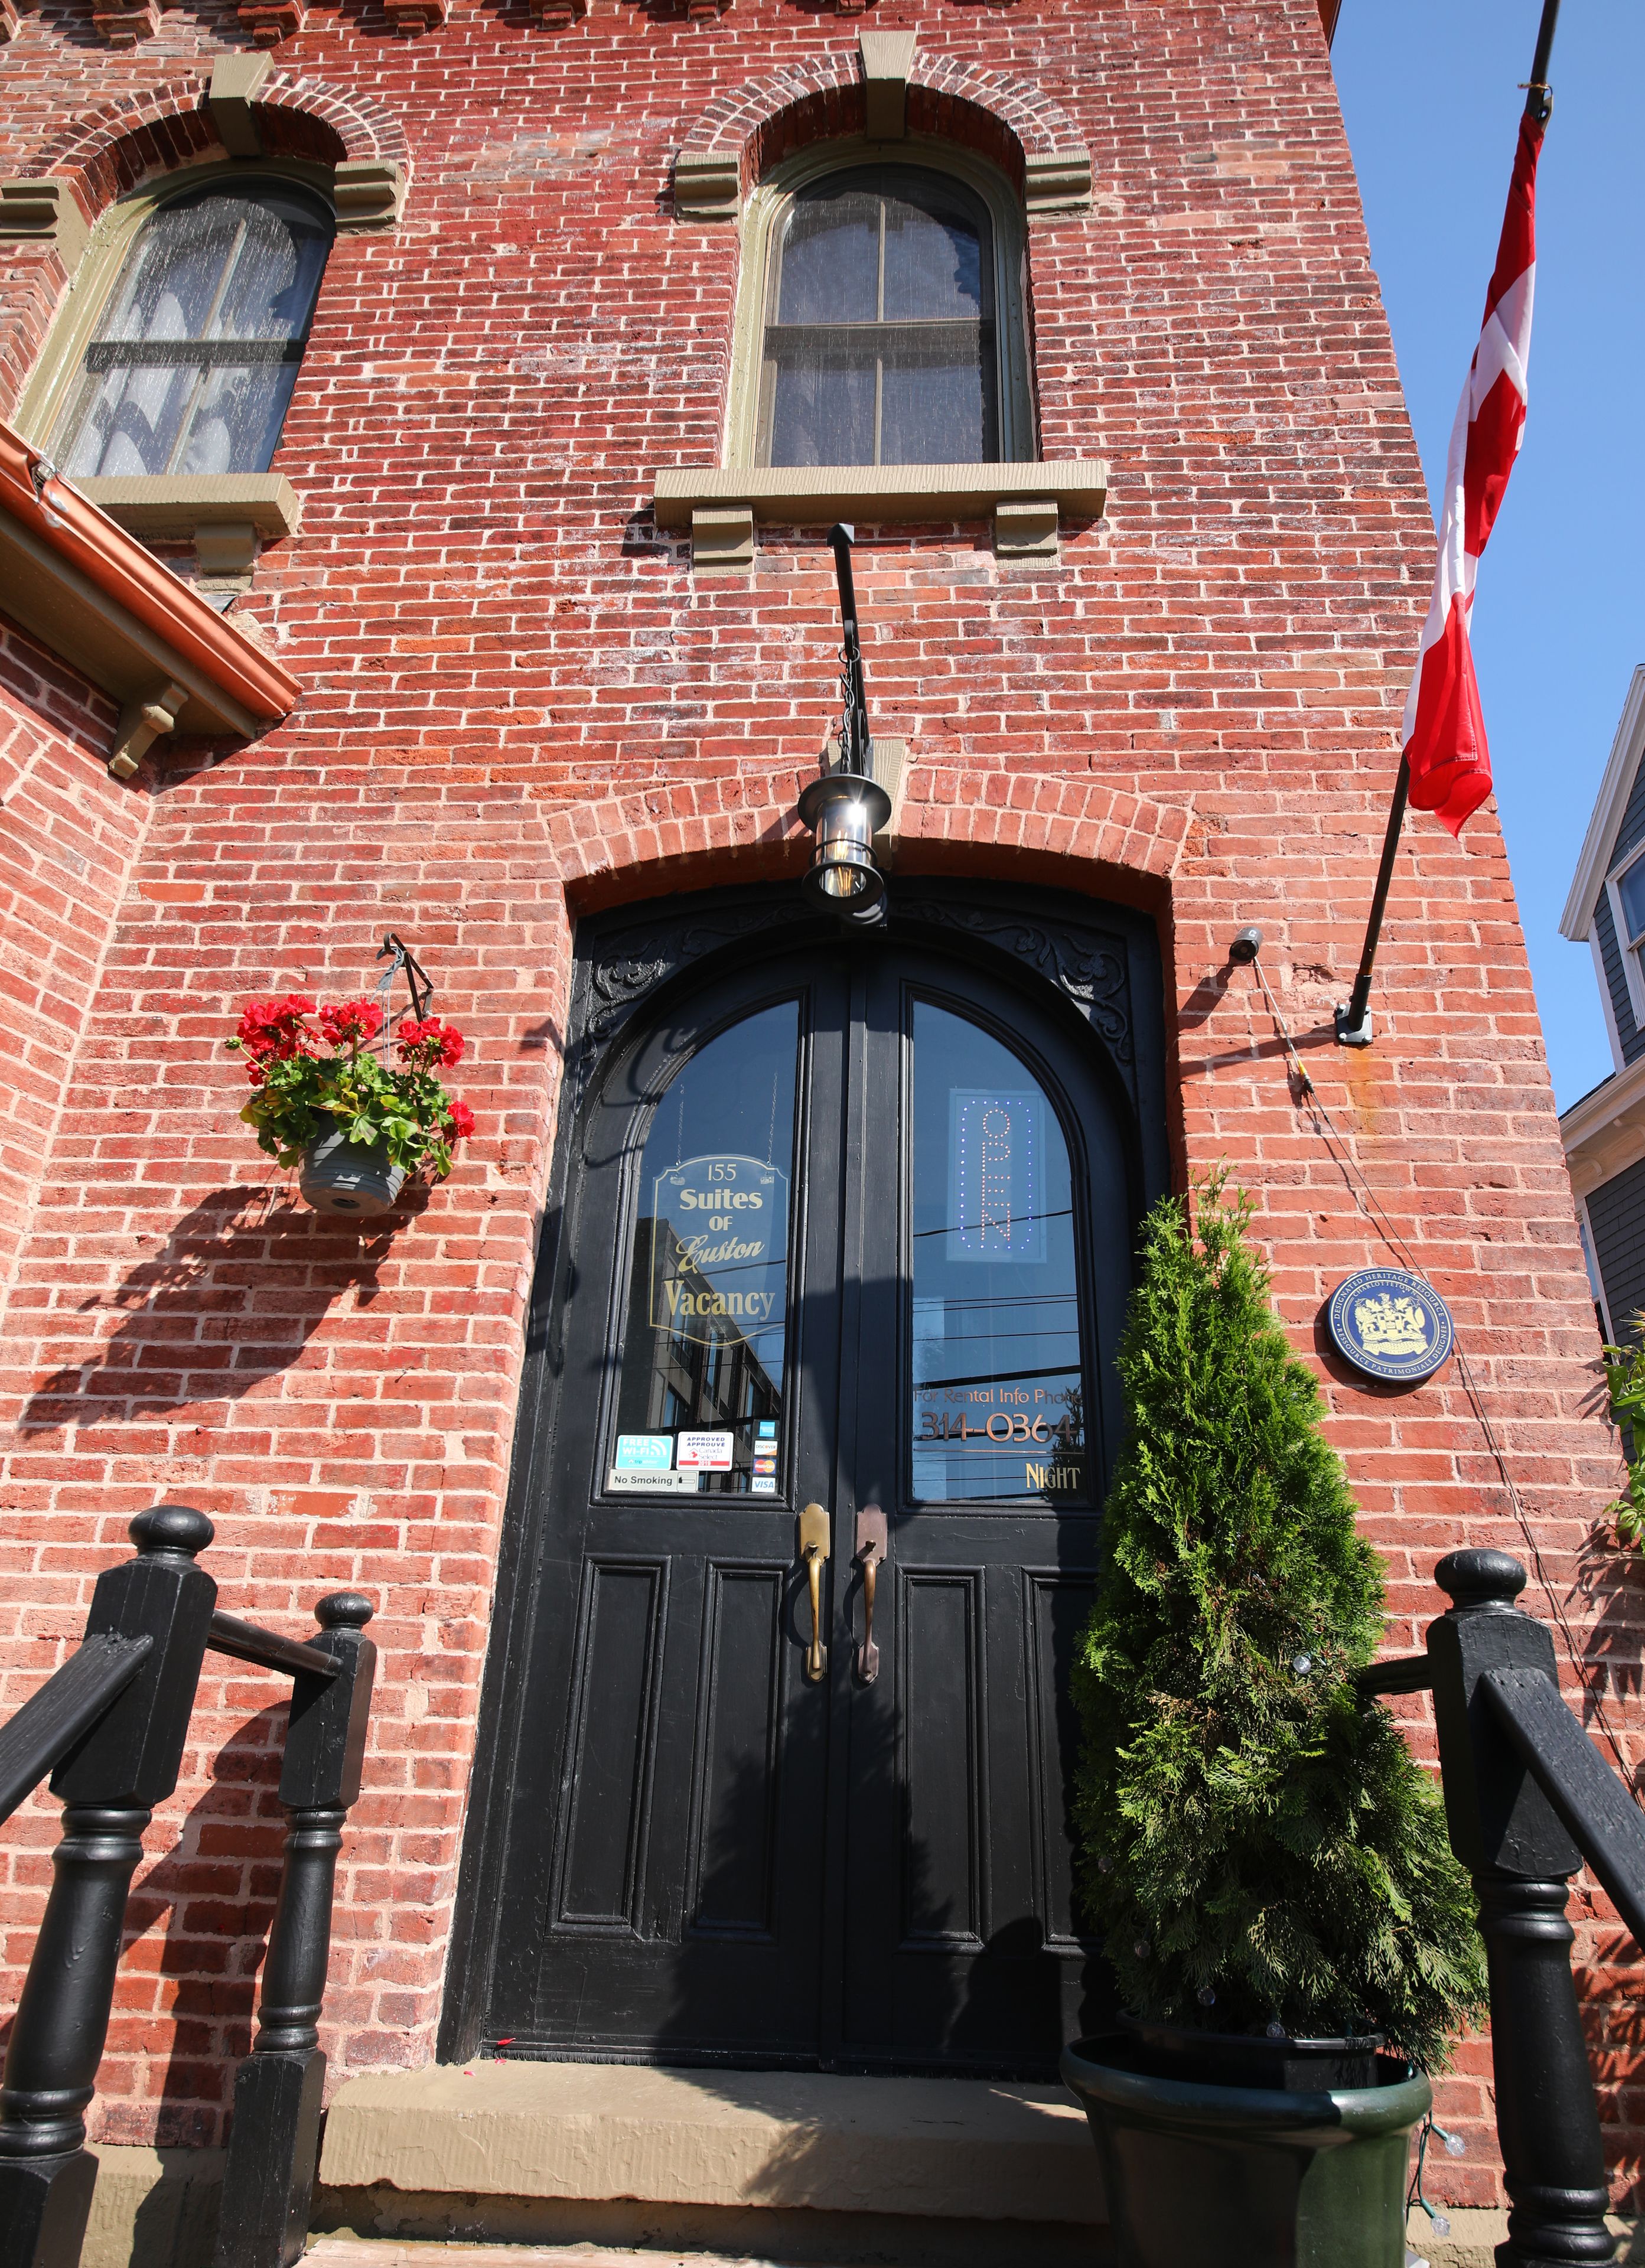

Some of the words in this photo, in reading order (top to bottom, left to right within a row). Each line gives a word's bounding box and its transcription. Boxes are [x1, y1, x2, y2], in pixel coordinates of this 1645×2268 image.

[709, 1164, 737, 1181] 155
[982, 1107, 1011, 1241] OPEN
[679, 1188, 763, 1210] Suites
[676, 1234, 764, 1273] Euston
[664, 1280, 776, 1321] Vacancy
[1334, 1278, 1363, 1319] DESIGNATED
[1364, 1273, 1409, 1283] HERITAGE
[1411, 1280, 1445, 1317] RESOURCE
[1353, 1281, 1418, 1297] CHARLOTTETOWN
[1336, 1327, 1369, 1366] RESSOURCE
[1372, 1358, 1434, 1374] PATRIMONIALE
[944, 1388, 994, 1404] Rental
[999, 1387, 1030, 1405] Info
[921, 1412, 1077, 1443] 314-0364
[623, 1438, 649, 1446] FREE
[623, 1446, 649, 1455] WI-FI
[630, 1476, 673, 1486] Smoking
[1025, 1463, 1081, 1489] NIGHT
